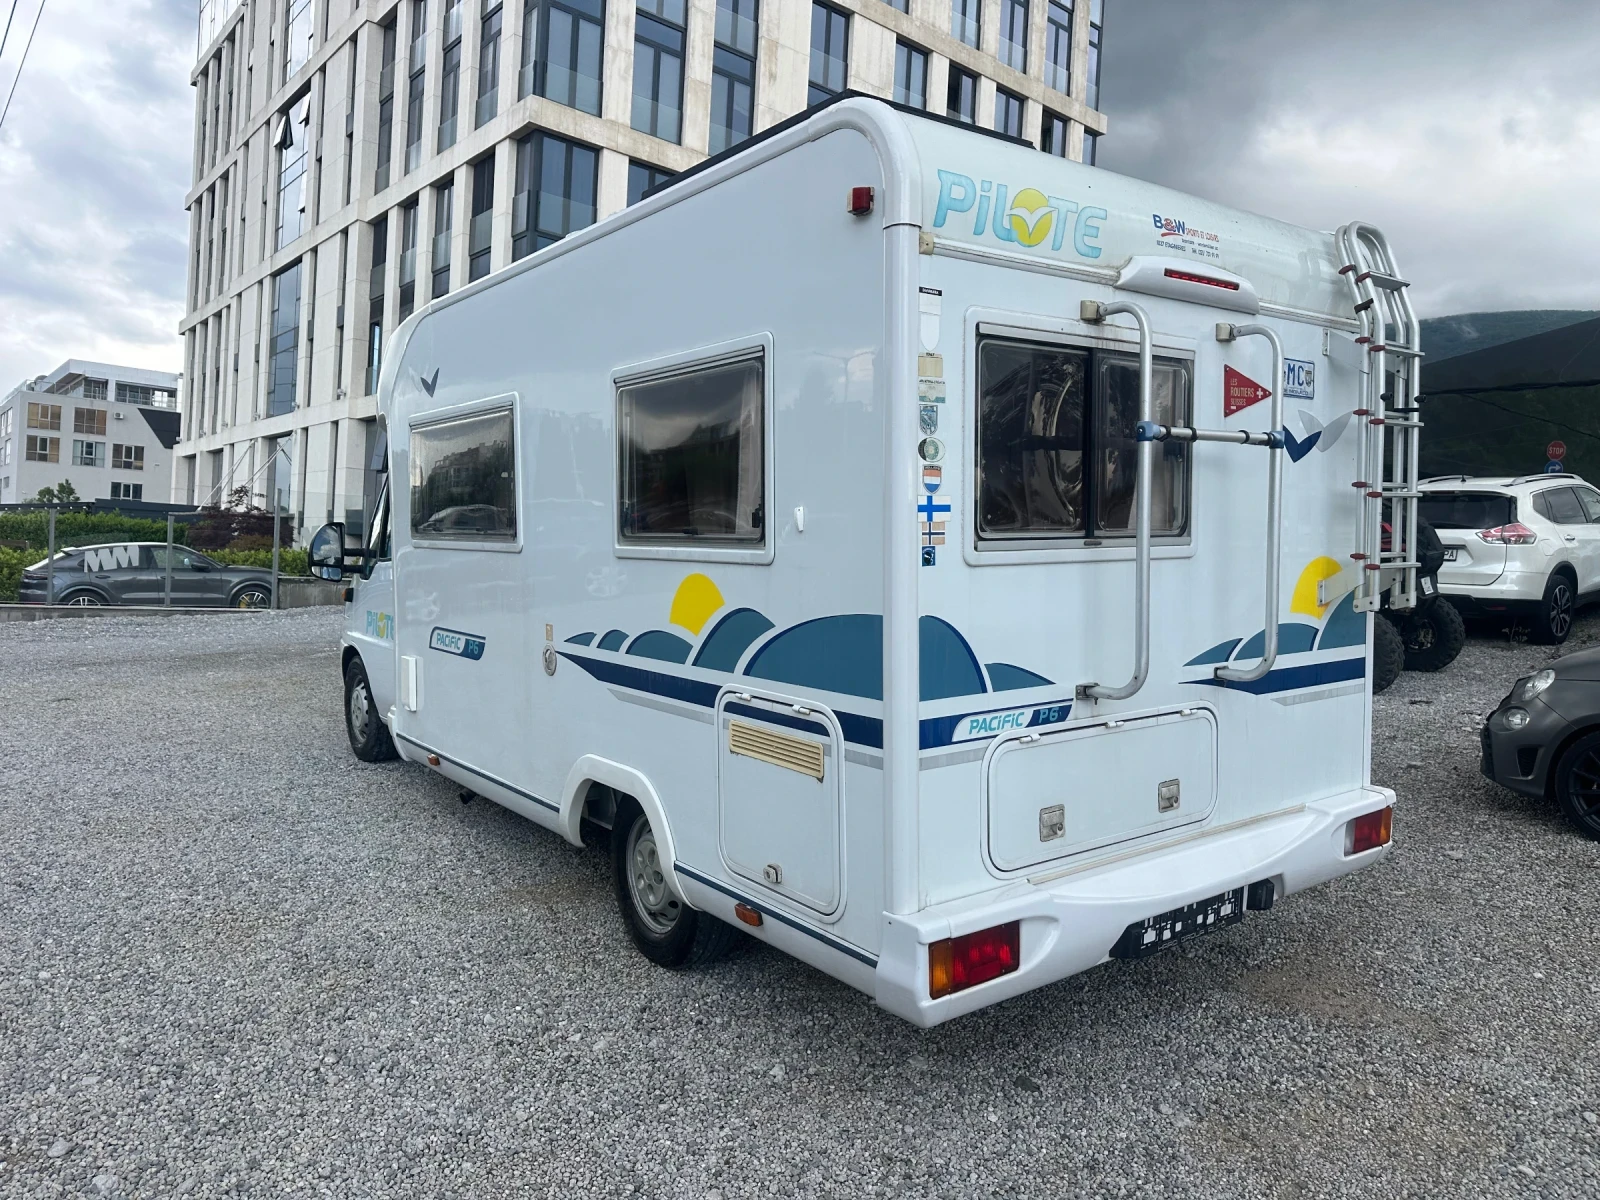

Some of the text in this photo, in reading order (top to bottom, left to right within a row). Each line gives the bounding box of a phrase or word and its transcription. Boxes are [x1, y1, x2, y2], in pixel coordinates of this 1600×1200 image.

[1152, 213, 1186, 235] B&W
[1287, 363, 1304, 386] MC
[1230, 378, 1238, 386] LES
[1230, 386, 1255, 398] ROUTIERS
[1230, 398, 1247, 406] SUISSES
[1548, 446, 1564, 455] STOP
[468, 640, 480, 655] P6
[1038, 706, 1060, 724] P6
